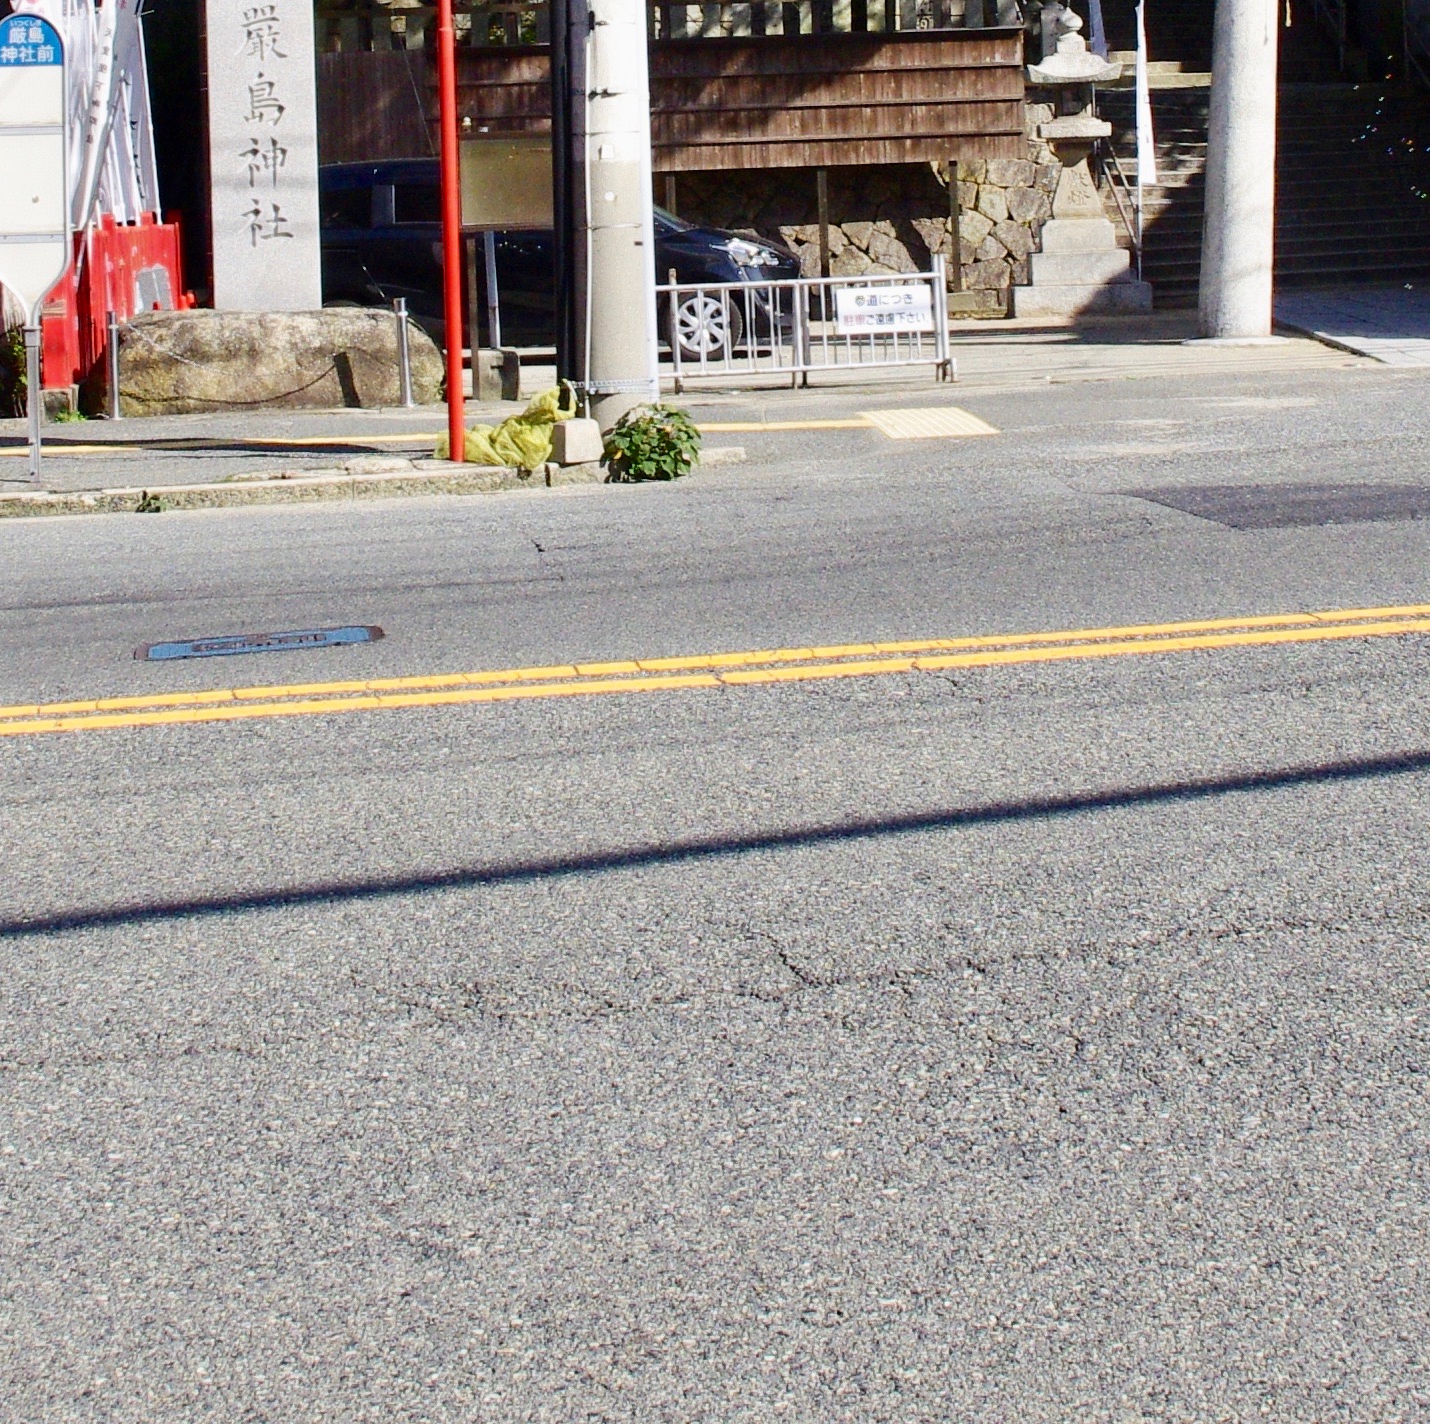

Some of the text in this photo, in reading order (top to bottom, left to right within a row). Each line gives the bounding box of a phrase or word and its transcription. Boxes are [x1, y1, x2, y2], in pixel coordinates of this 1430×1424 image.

[9, 27, 45, 44] 厳島
[0, 44, 55, 64] 神社前
